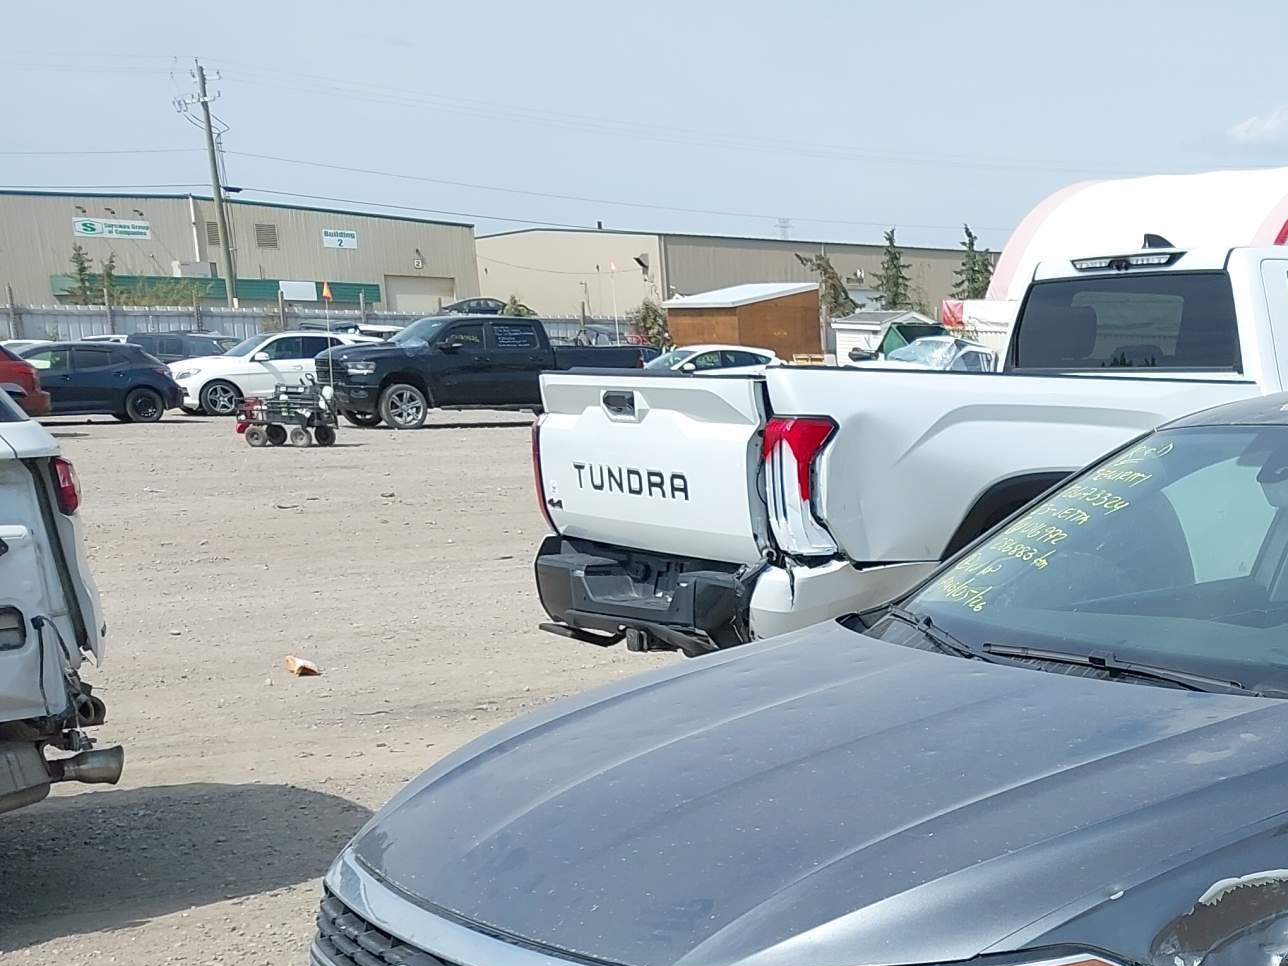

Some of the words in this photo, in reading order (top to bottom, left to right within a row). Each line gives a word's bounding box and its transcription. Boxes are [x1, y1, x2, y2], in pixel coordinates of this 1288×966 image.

[323, 230, 356, 239] Building
[337, 238, 344, 247] 2
[572, 462, 690, 501] TUNDRA
